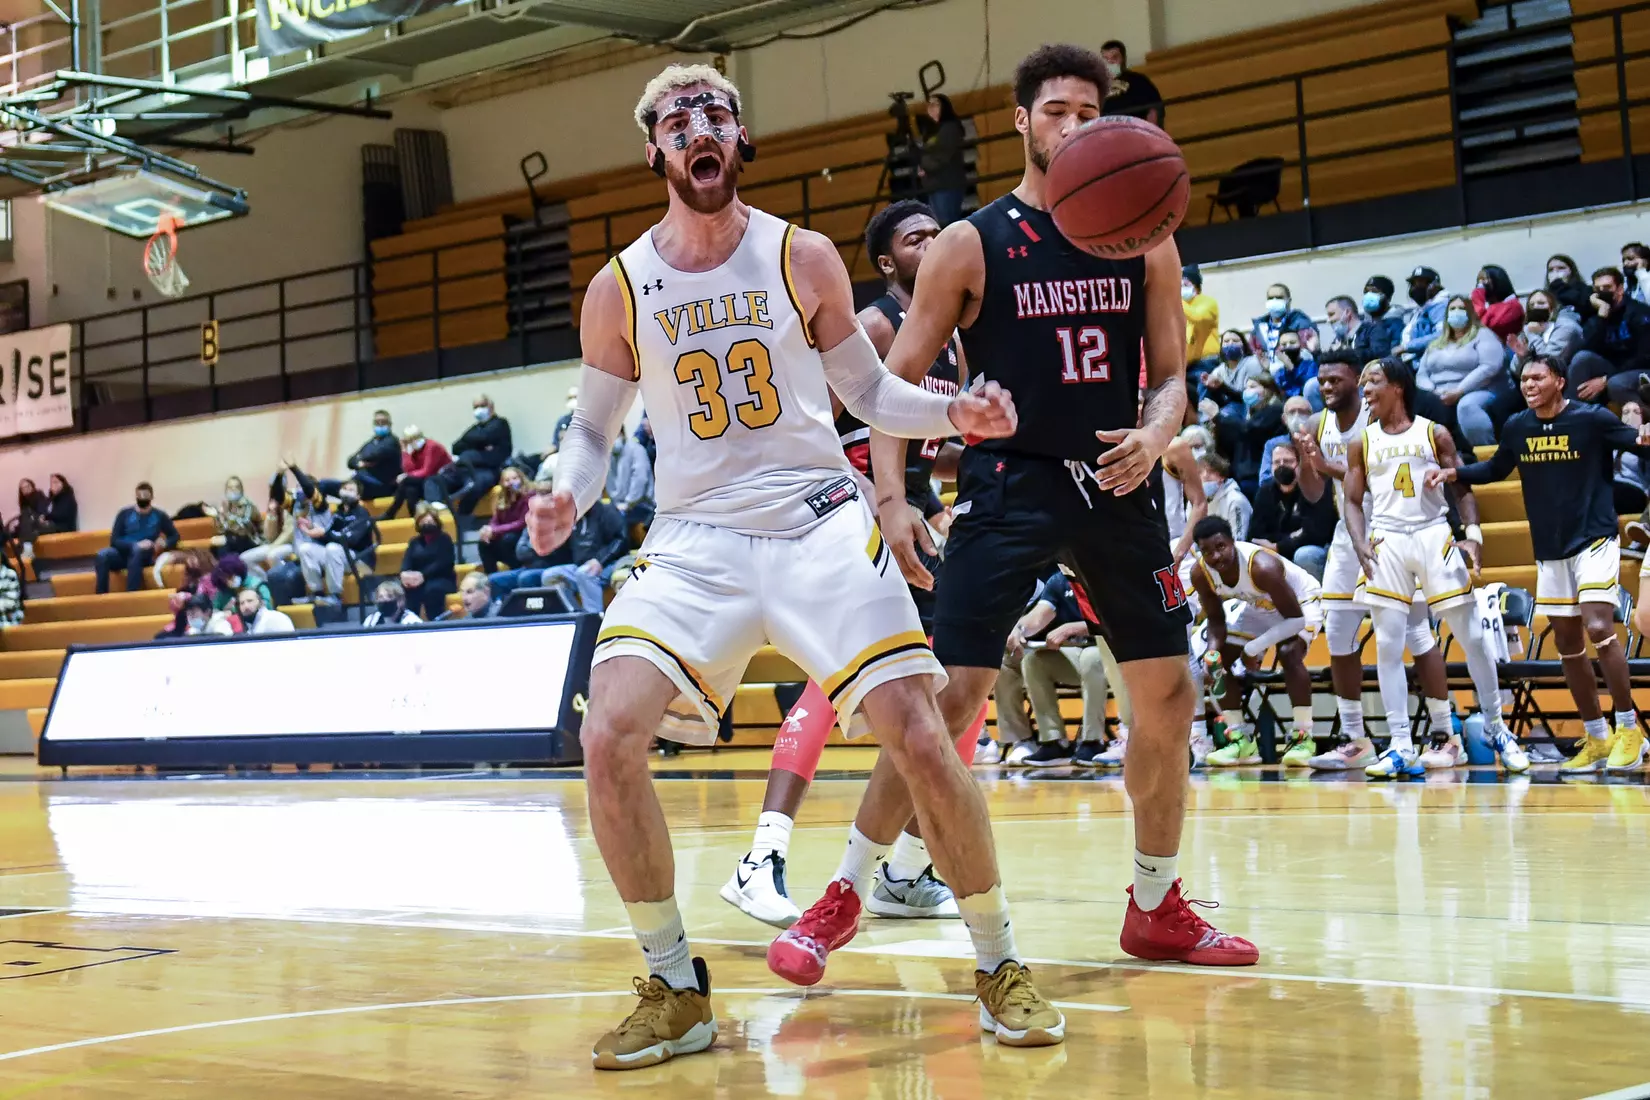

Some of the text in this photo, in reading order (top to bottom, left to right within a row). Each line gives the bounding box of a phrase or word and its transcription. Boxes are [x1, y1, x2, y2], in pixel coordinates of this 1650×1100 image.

[1013, 277, 1132, 319] MANSFIELD
[653, 290, 774, 346] VILLE
[202, 324, 217, 361] B
[1055, 325, 1111, 384] 12
[673, 338, 783, 440] 33
[1374, 444, 1427, 463] VILLE
[1519, 450, 1581, 463] BASKETBALL
[1525, 435, 1569, 453] VILLE
[1392, 462, 1416, 498] 4
